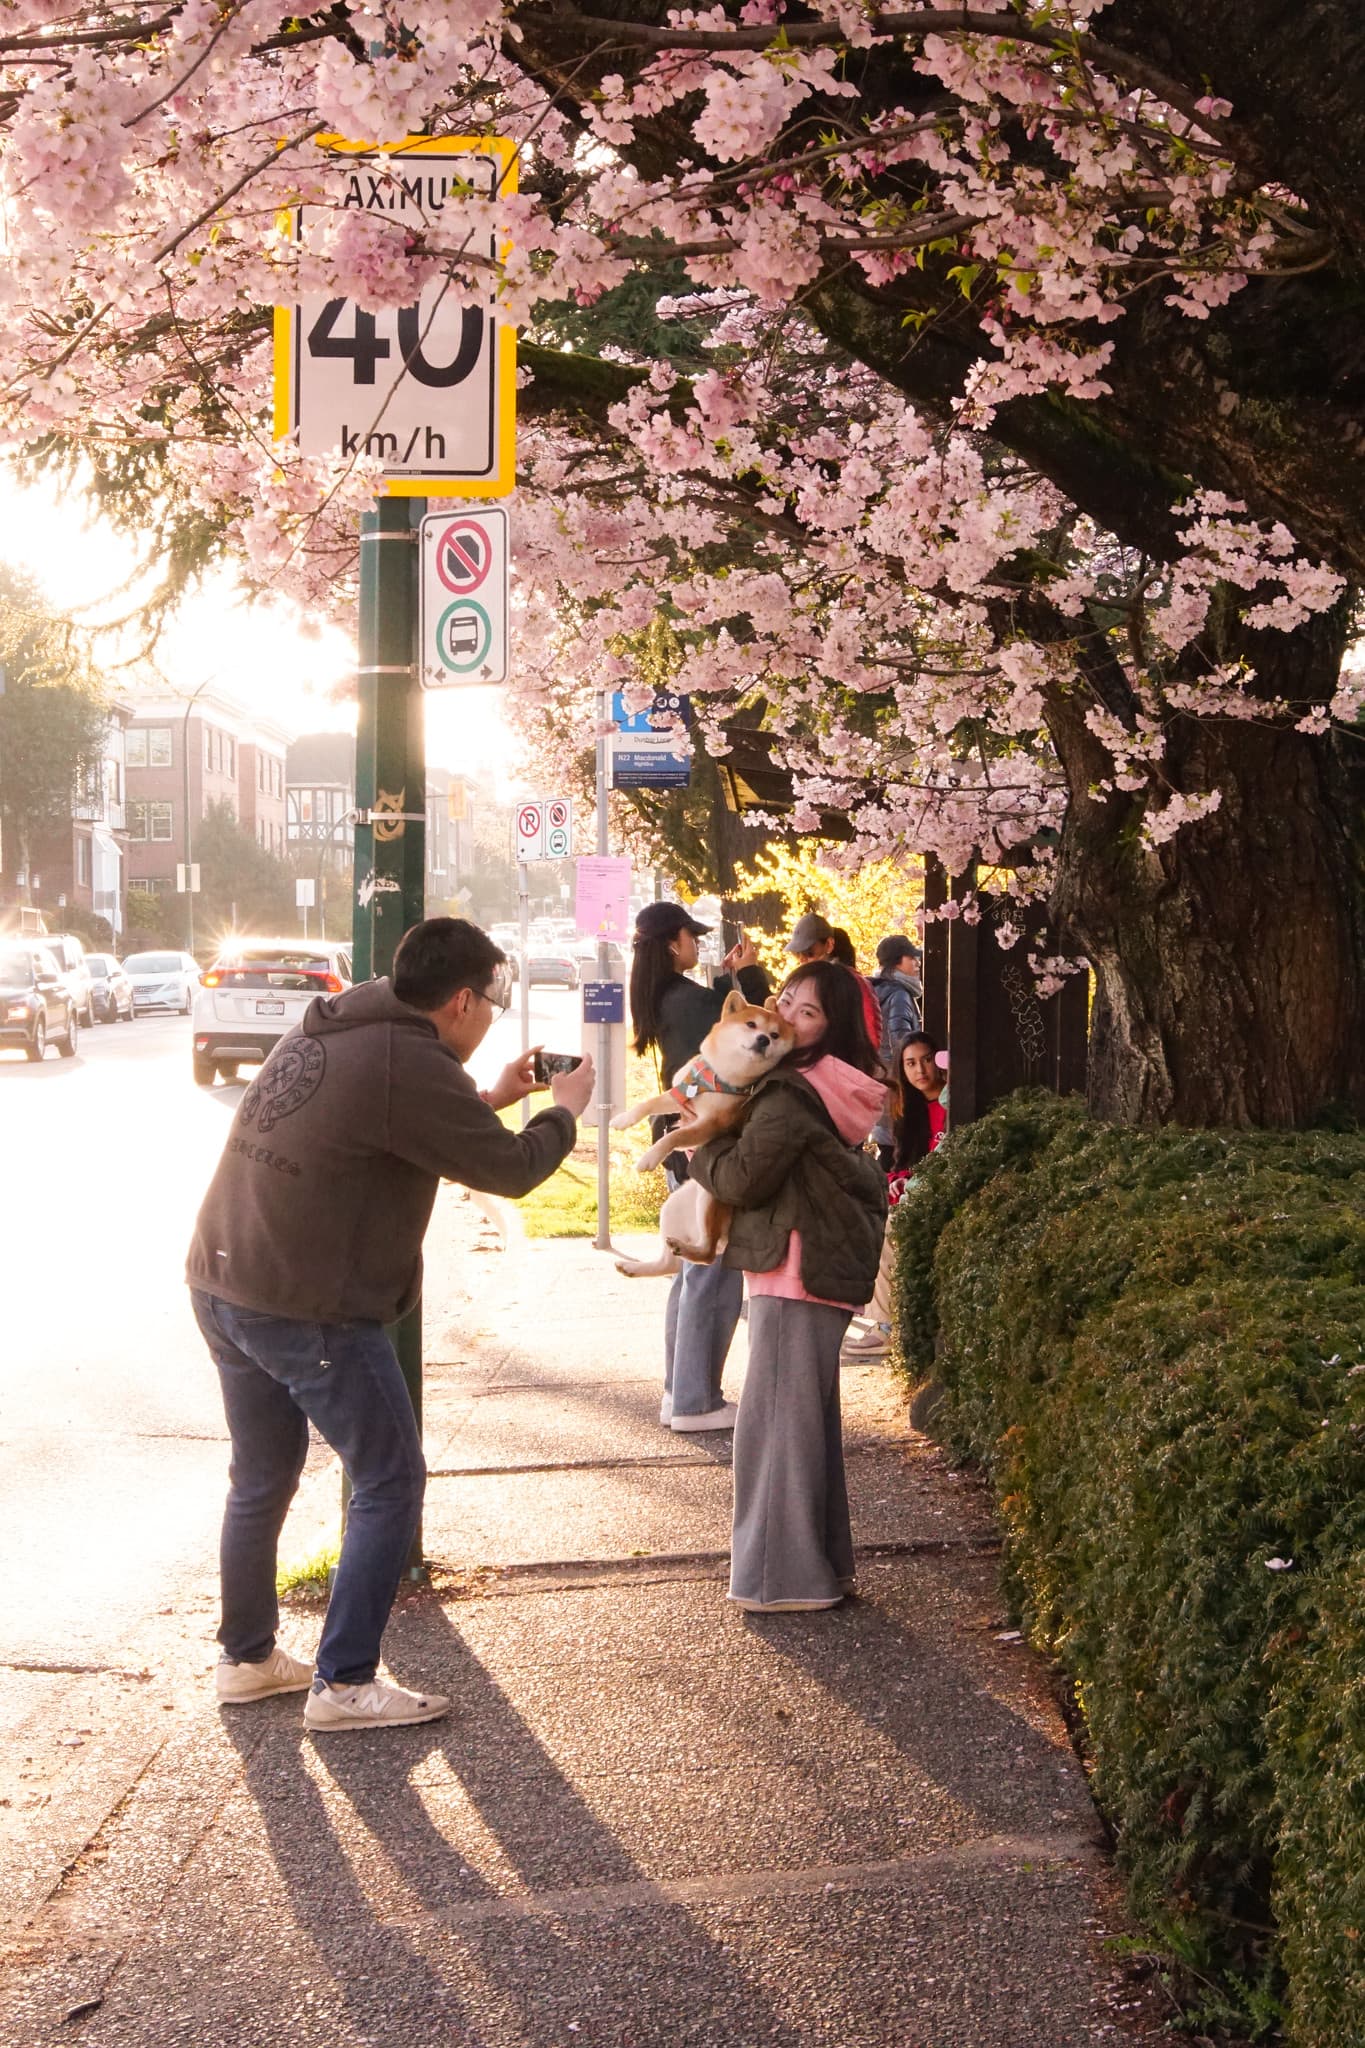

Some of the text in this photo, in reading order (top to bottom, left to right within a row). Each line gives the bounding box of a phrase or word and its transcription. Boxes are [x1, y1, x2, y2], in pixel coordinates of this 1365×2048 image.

[307, 296, 484, 388] 40
[341, 424, 446, 464] km/h
[273, 1658, 296, 1681] N
[359, 1690, 392, 1714] N
